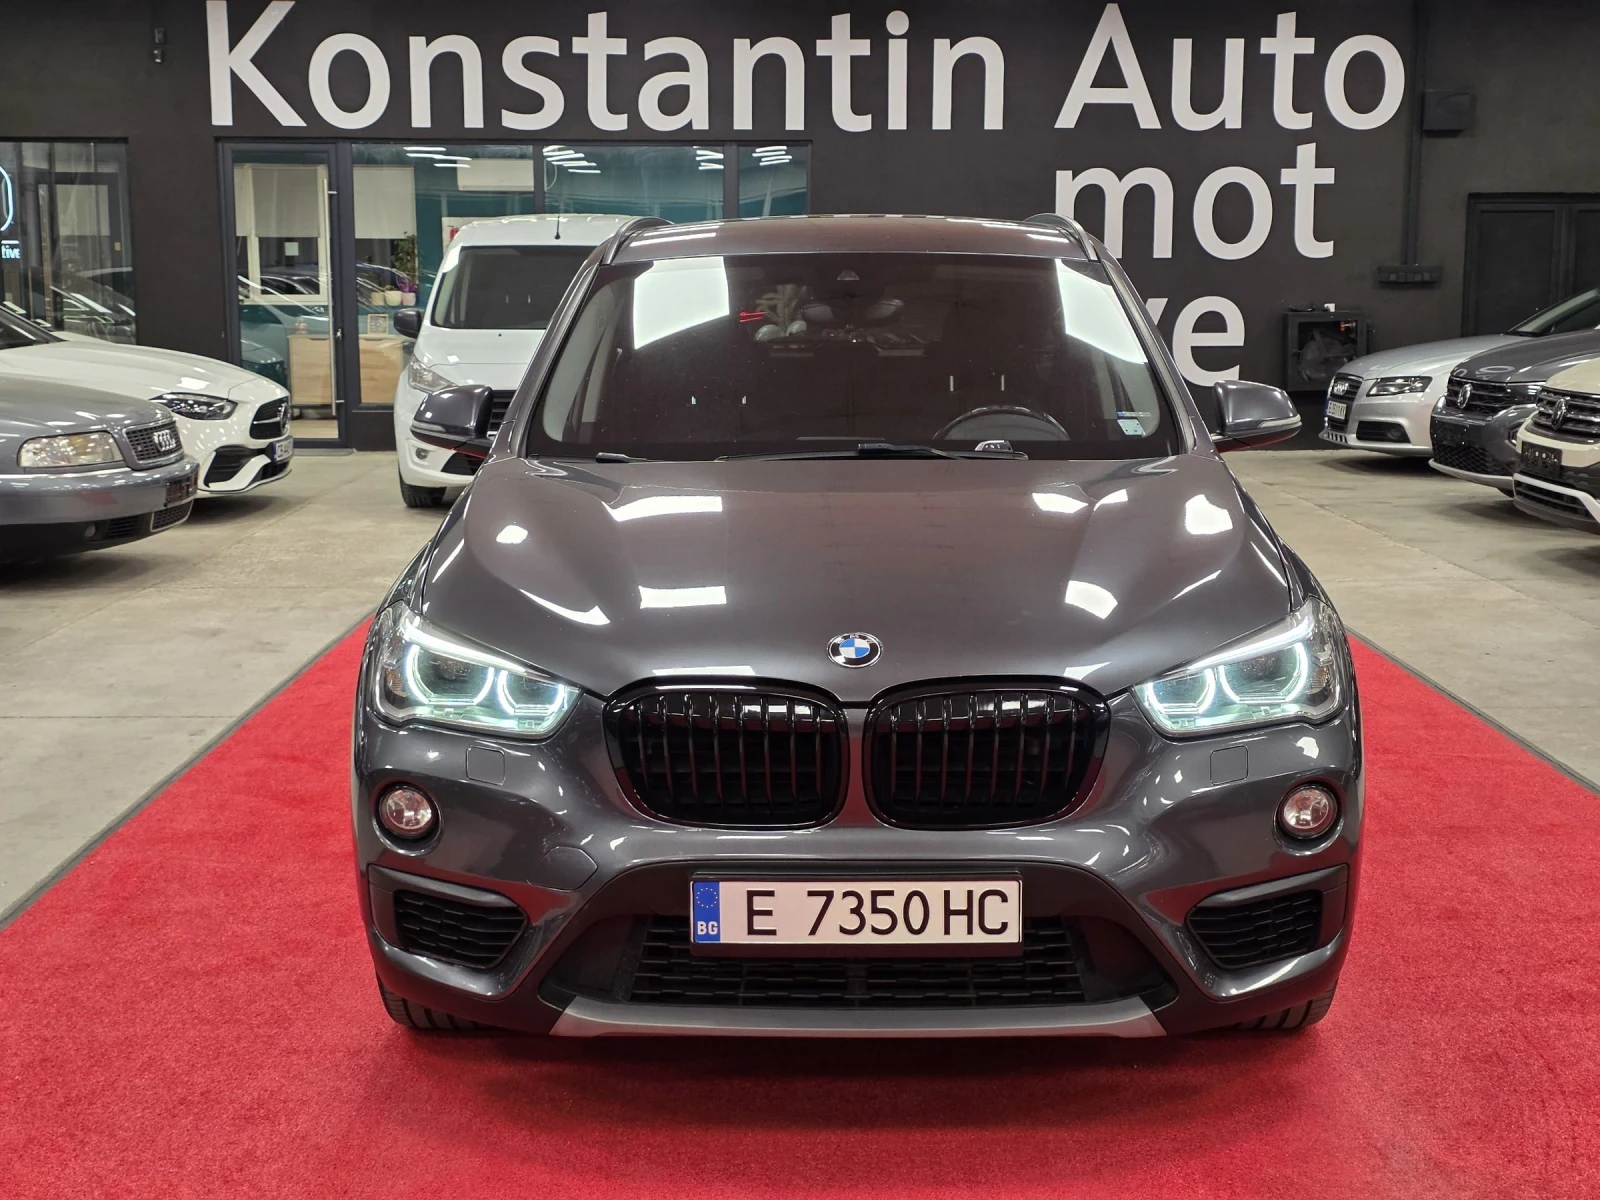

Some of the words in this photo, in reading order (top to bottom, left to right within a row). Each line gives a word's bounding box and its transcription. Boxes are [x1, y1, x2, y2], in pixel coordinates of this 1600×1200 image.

[206, 0, 1005, 132] Konstantin
[1053, 3, 1405, 131] Auto
[1055, 142, 1336, 260] mot
[697, 920, 719, 935] BG
[746, 889, 777, 936] E
[806, 889, 930, 936] 7350
[943, 889, 1009, 936] HC
